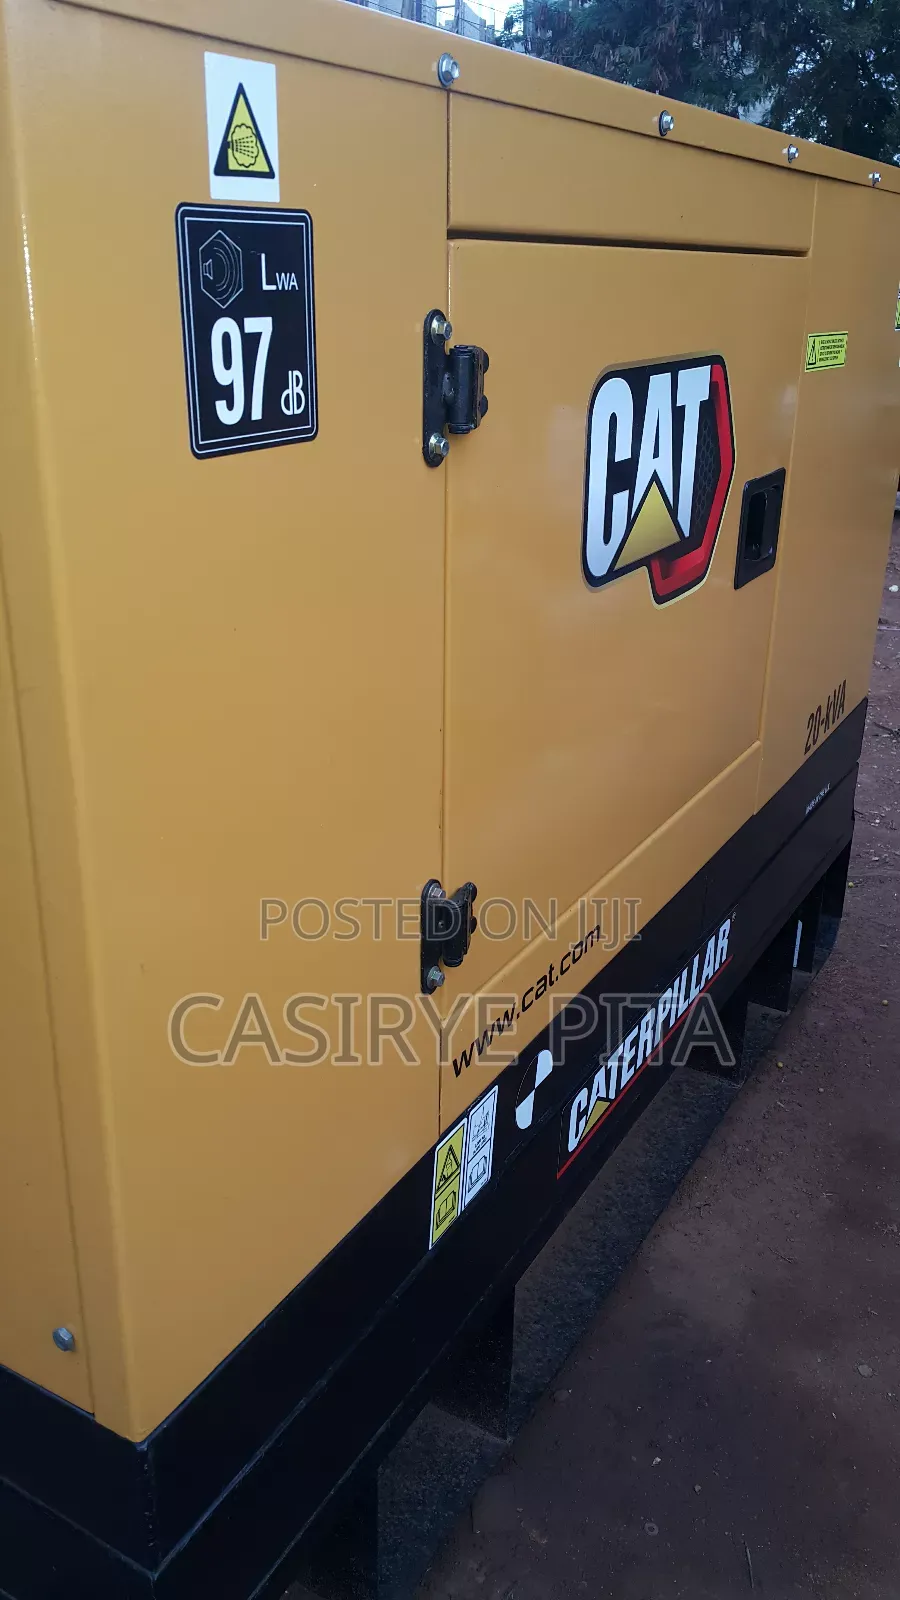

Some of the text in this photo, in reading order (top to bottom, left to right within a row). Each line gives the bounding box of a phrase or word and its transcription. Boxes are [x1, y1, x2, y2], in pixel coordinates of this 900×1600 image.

[210, 316, 305, 425] 97 dB
[585, 364, 712, 577] CAT
[803, 679, 847, 756] 20-kVA
[452, 923, 602, 1078] www.cat.com
[568, 918, 732, 1153] CATERPILLAR
